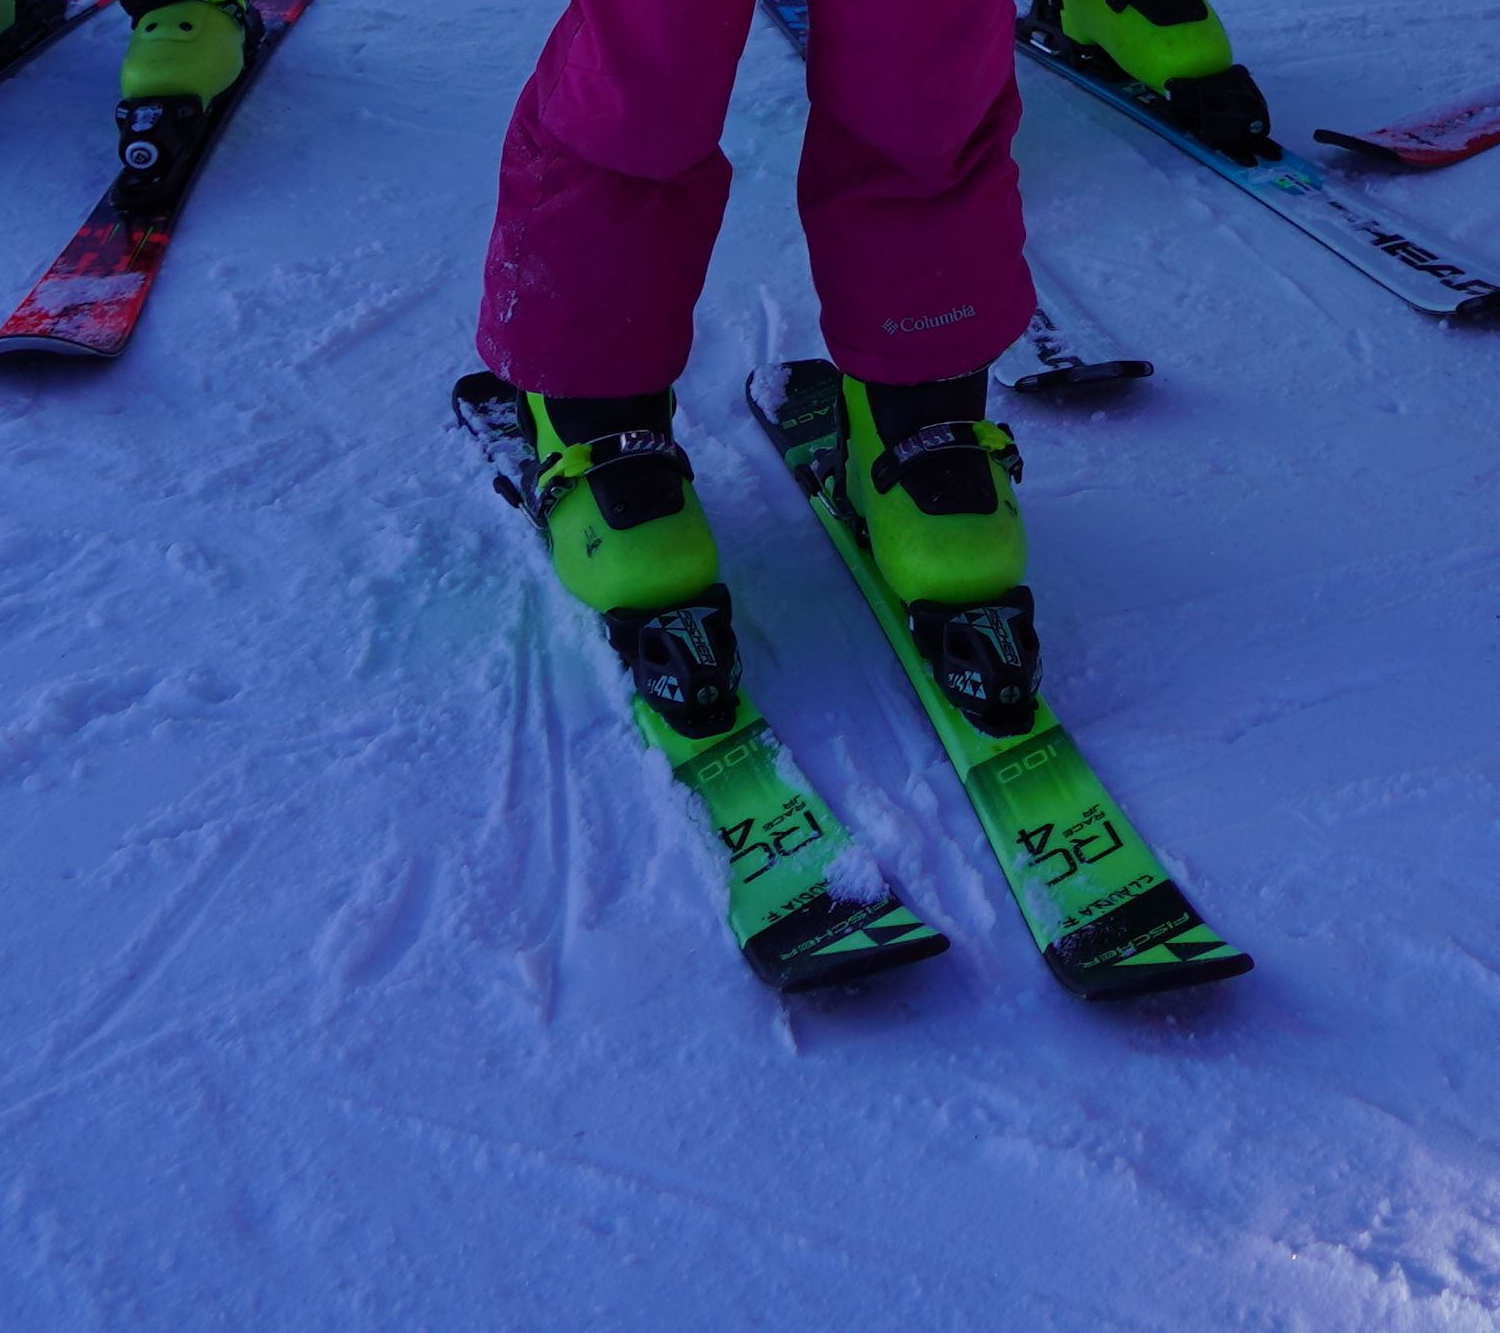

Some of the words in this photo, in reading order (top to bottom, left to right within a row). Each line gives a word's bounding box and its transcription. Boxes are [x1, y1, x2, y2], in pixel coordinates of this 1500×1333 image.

[900, 304, 976, 332] Columbia
[997, 744, 1057, 783] 100
[762, 801, 807, 832] RACE
[1062, 810, 1107, 838] RACE
[779, 899, 892, 962] FISCHER
[1082, 911, 1193, 972] FISCHER
